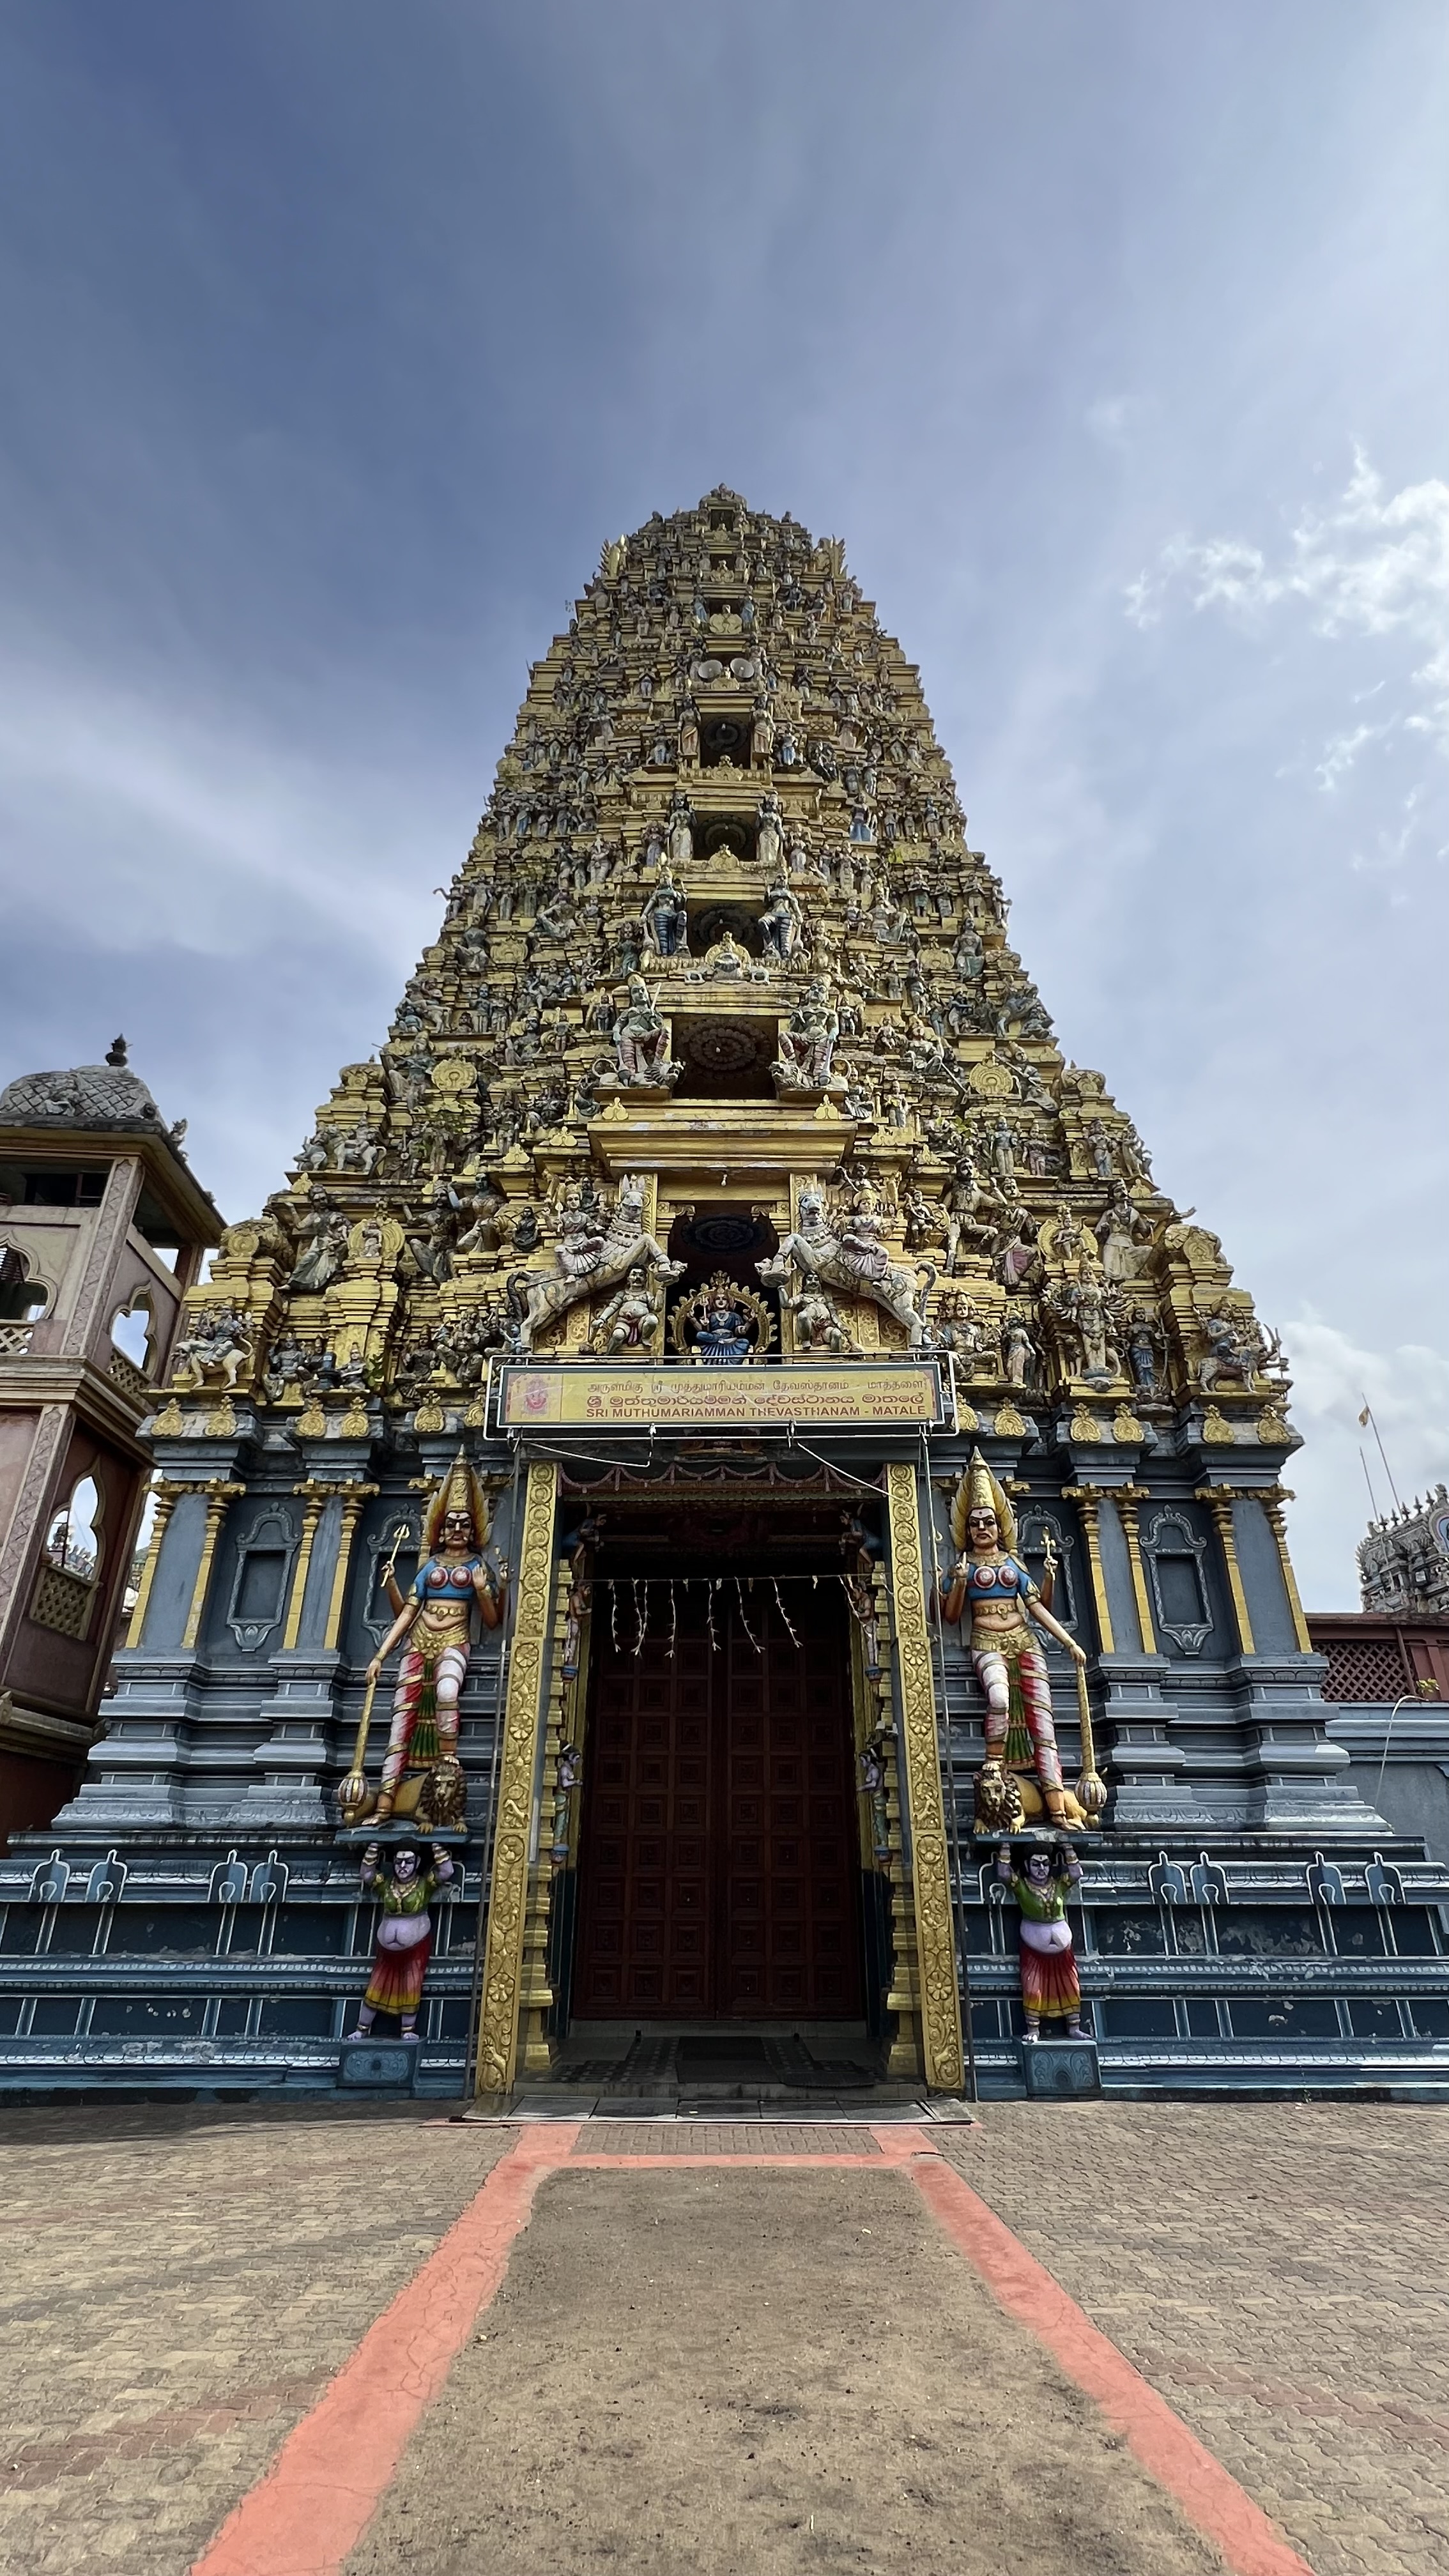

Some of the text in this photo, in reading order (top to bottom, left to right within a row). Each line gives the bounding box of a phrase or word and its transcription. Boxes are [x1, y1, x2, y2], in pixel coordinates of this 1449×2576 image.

[773, 1379, 850, 1393] தேவஸ்தானம்
[862, 1392, 924, 1404] මාතලේ
[586, 1408, 608, 1418] SRI
[613, 1407, 745, 1418] MUTHUMARIAMMAN
[749, 1406, 860, 1416] THEVASTHANAM
[872, 1406, 926, 1416] MATALE
